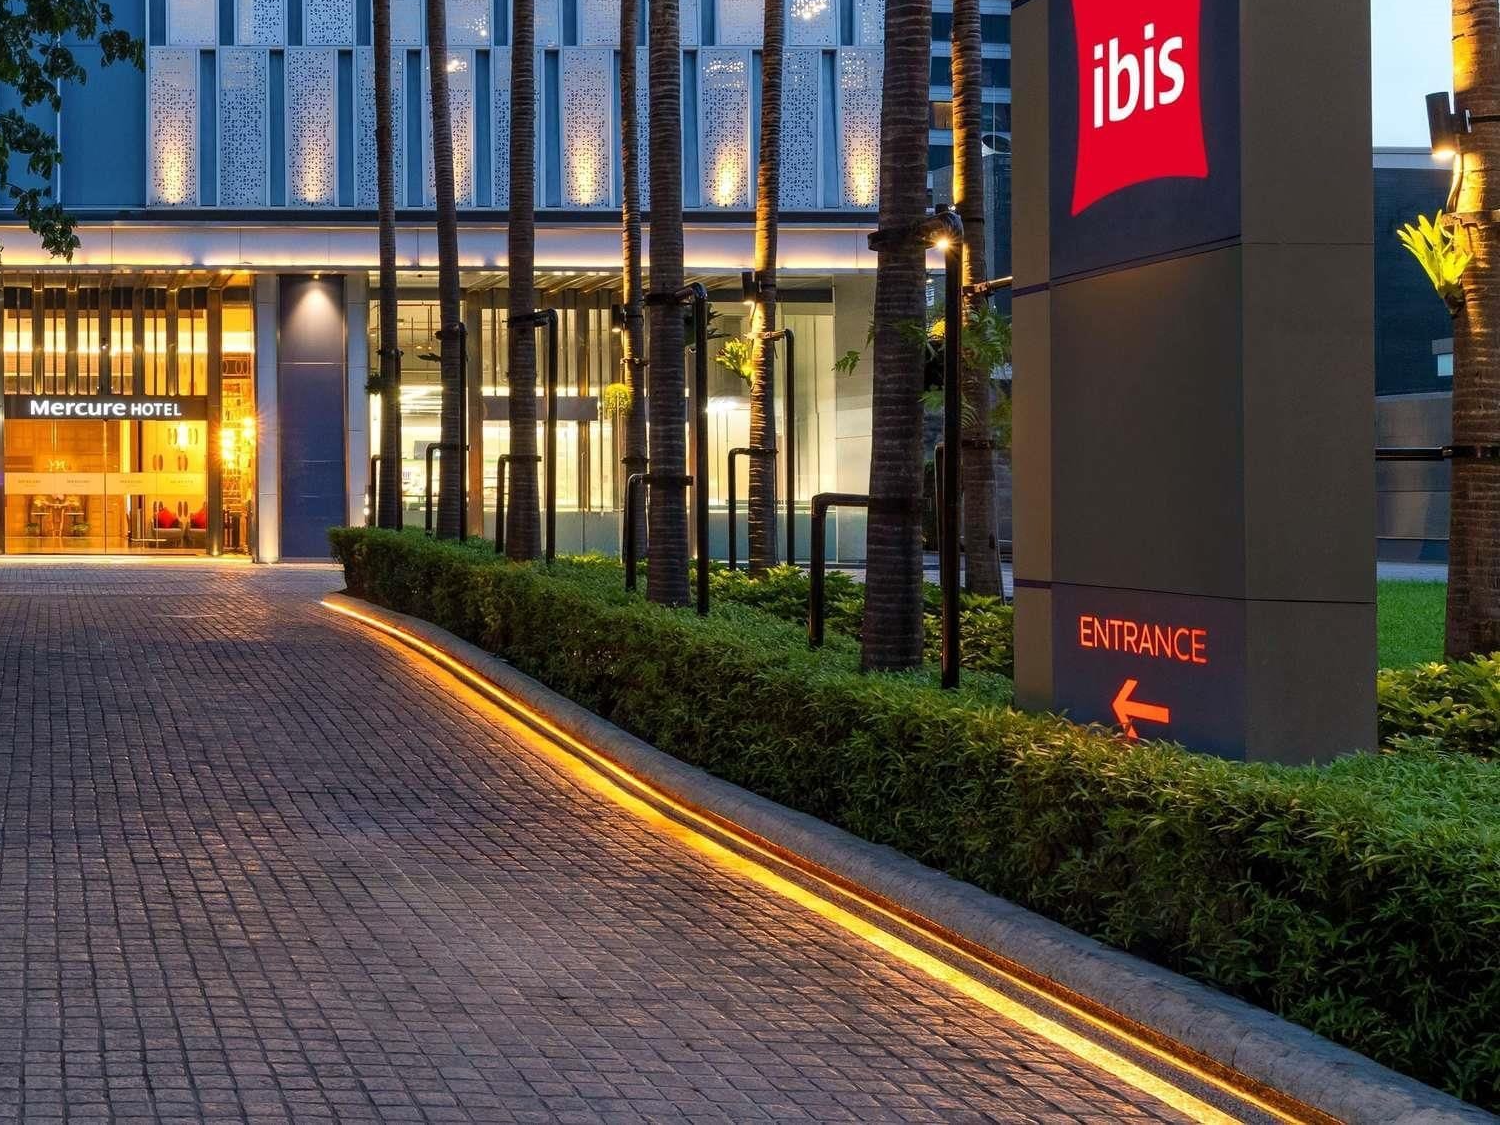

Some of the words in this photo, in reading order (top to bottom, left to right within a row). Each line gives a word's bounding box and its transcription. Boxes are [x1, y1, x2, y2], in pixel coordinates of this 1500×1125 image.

[1093, 23, 1185, 129] ibis
[30, 399, 127, 417] Mercure
[130, 402, 182, 417] HOTEL
[1078, 615, 1208, 664] ENTRANCE
